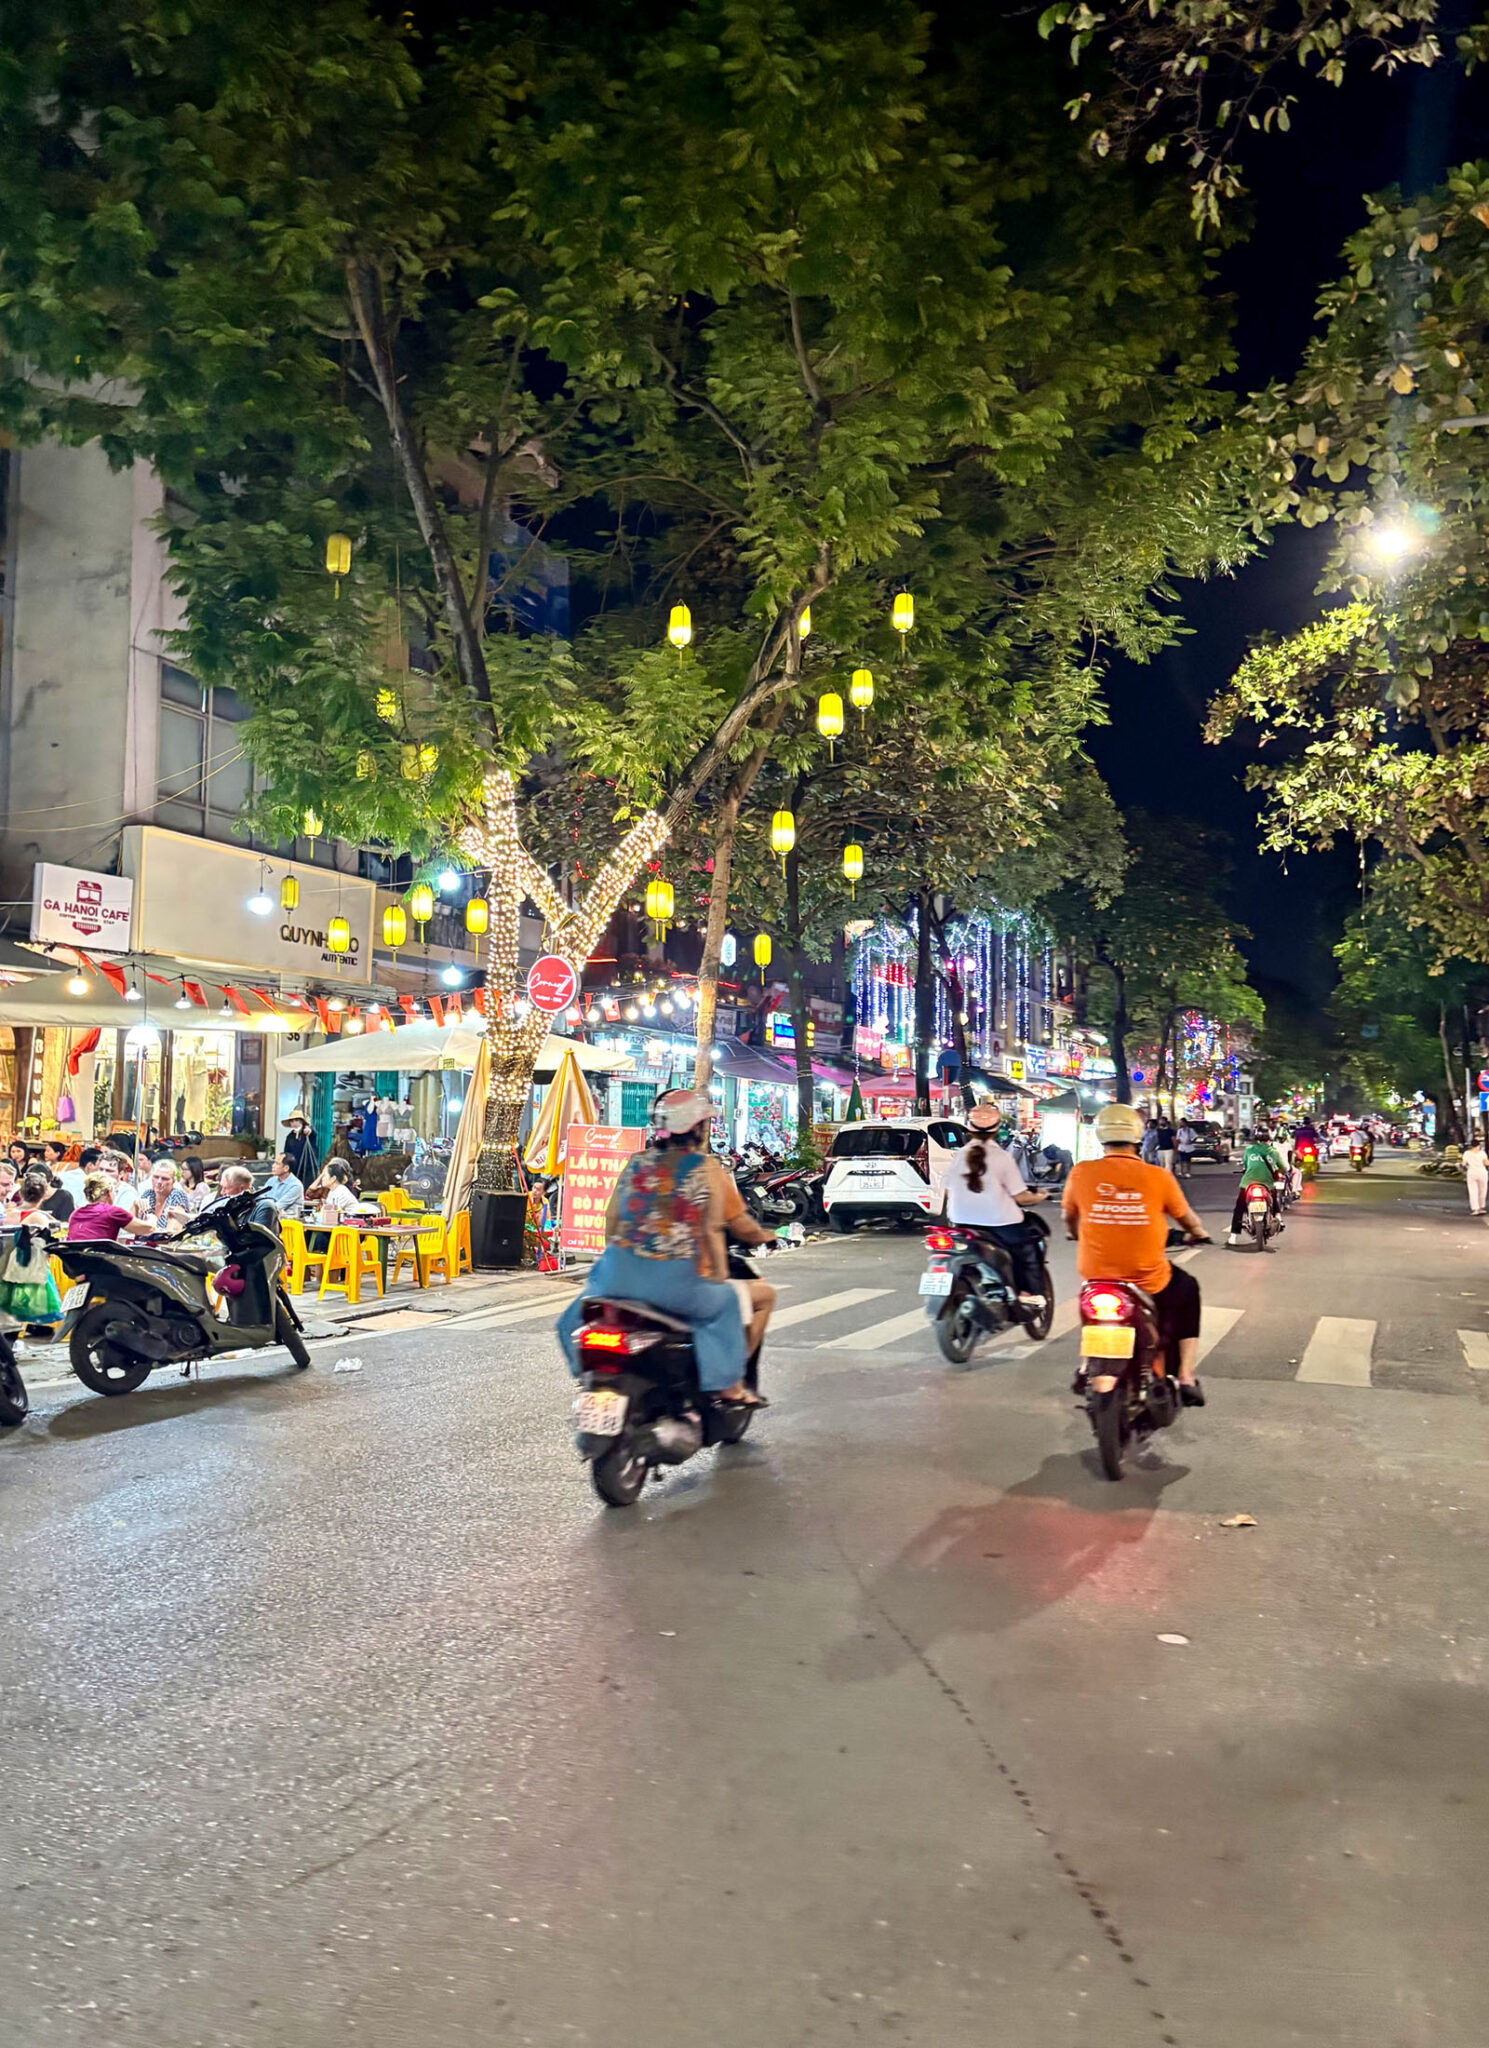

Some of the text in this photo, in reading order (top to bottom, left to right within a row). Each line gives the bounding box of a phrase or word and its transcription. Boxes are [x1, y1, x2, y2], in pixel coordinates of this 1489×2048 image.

[43, 899, 60, 911] GA
[64, 902, 98, 917] HANOI
[573, 1213, 607, 1230] NƯỚ
[584, 1233, 606, 1248] 119
